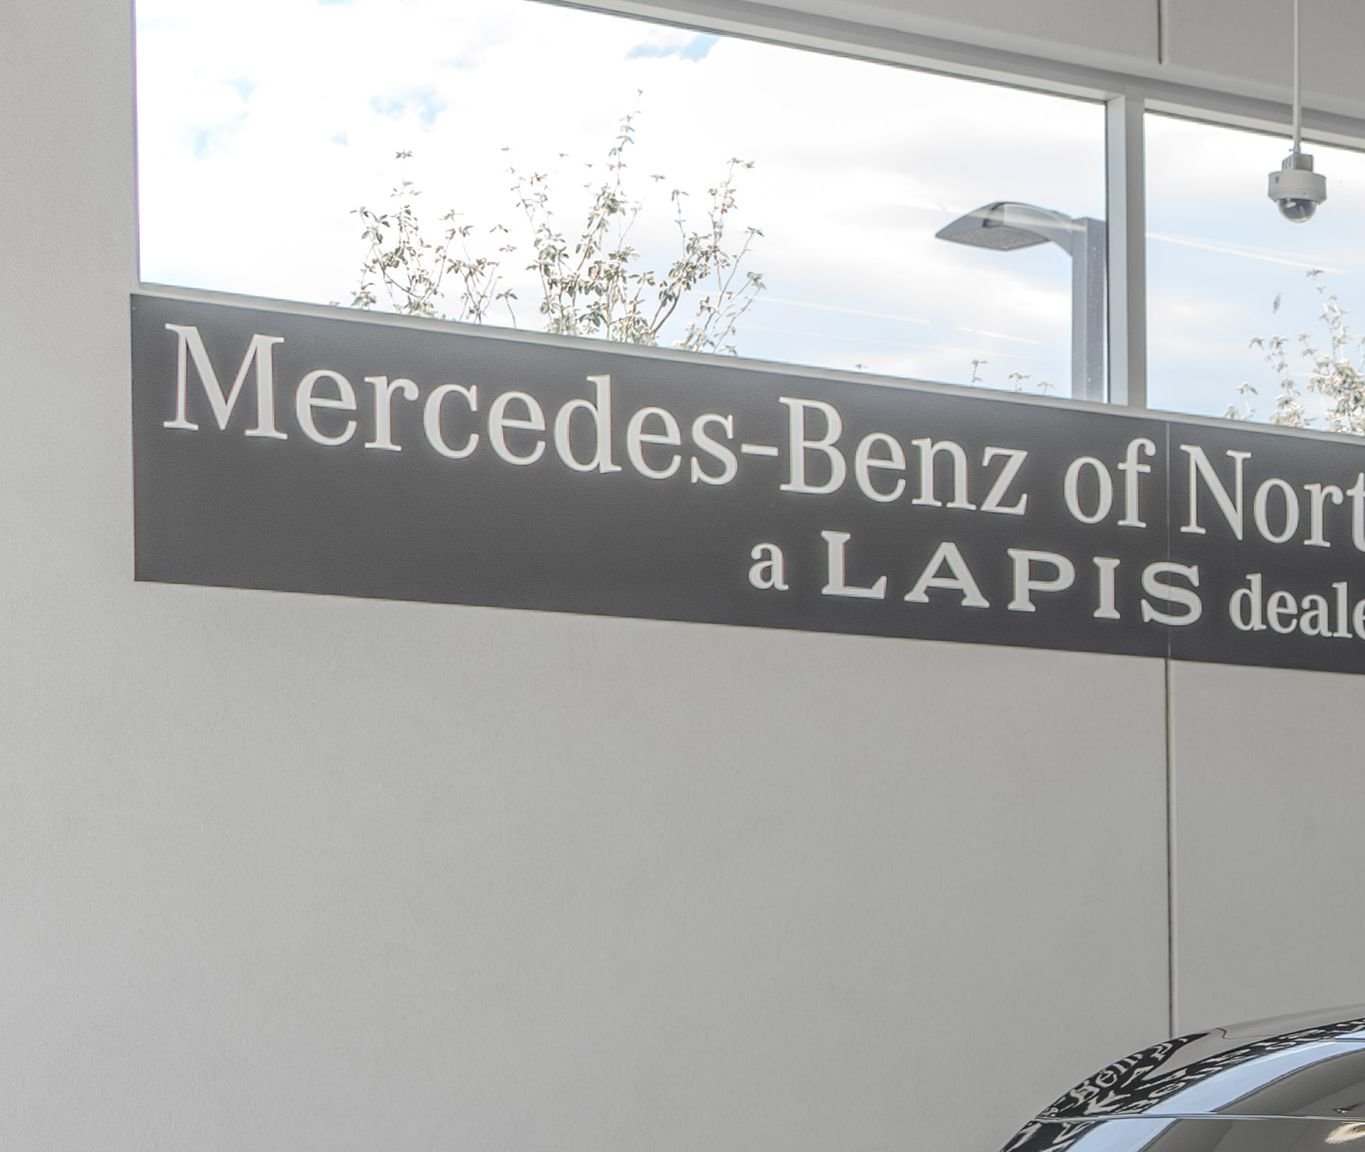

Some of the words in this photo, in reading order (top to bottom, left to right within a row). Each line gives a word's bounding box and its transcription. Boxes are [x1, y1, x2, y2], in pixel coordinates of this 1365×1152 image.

[162, 322, 1031, 516] Mercedes-Benz
[1063, 437, 1157, 528] of
[748, 542, 789, 591] a
[820, 529, 1203, 626] LAPIS
